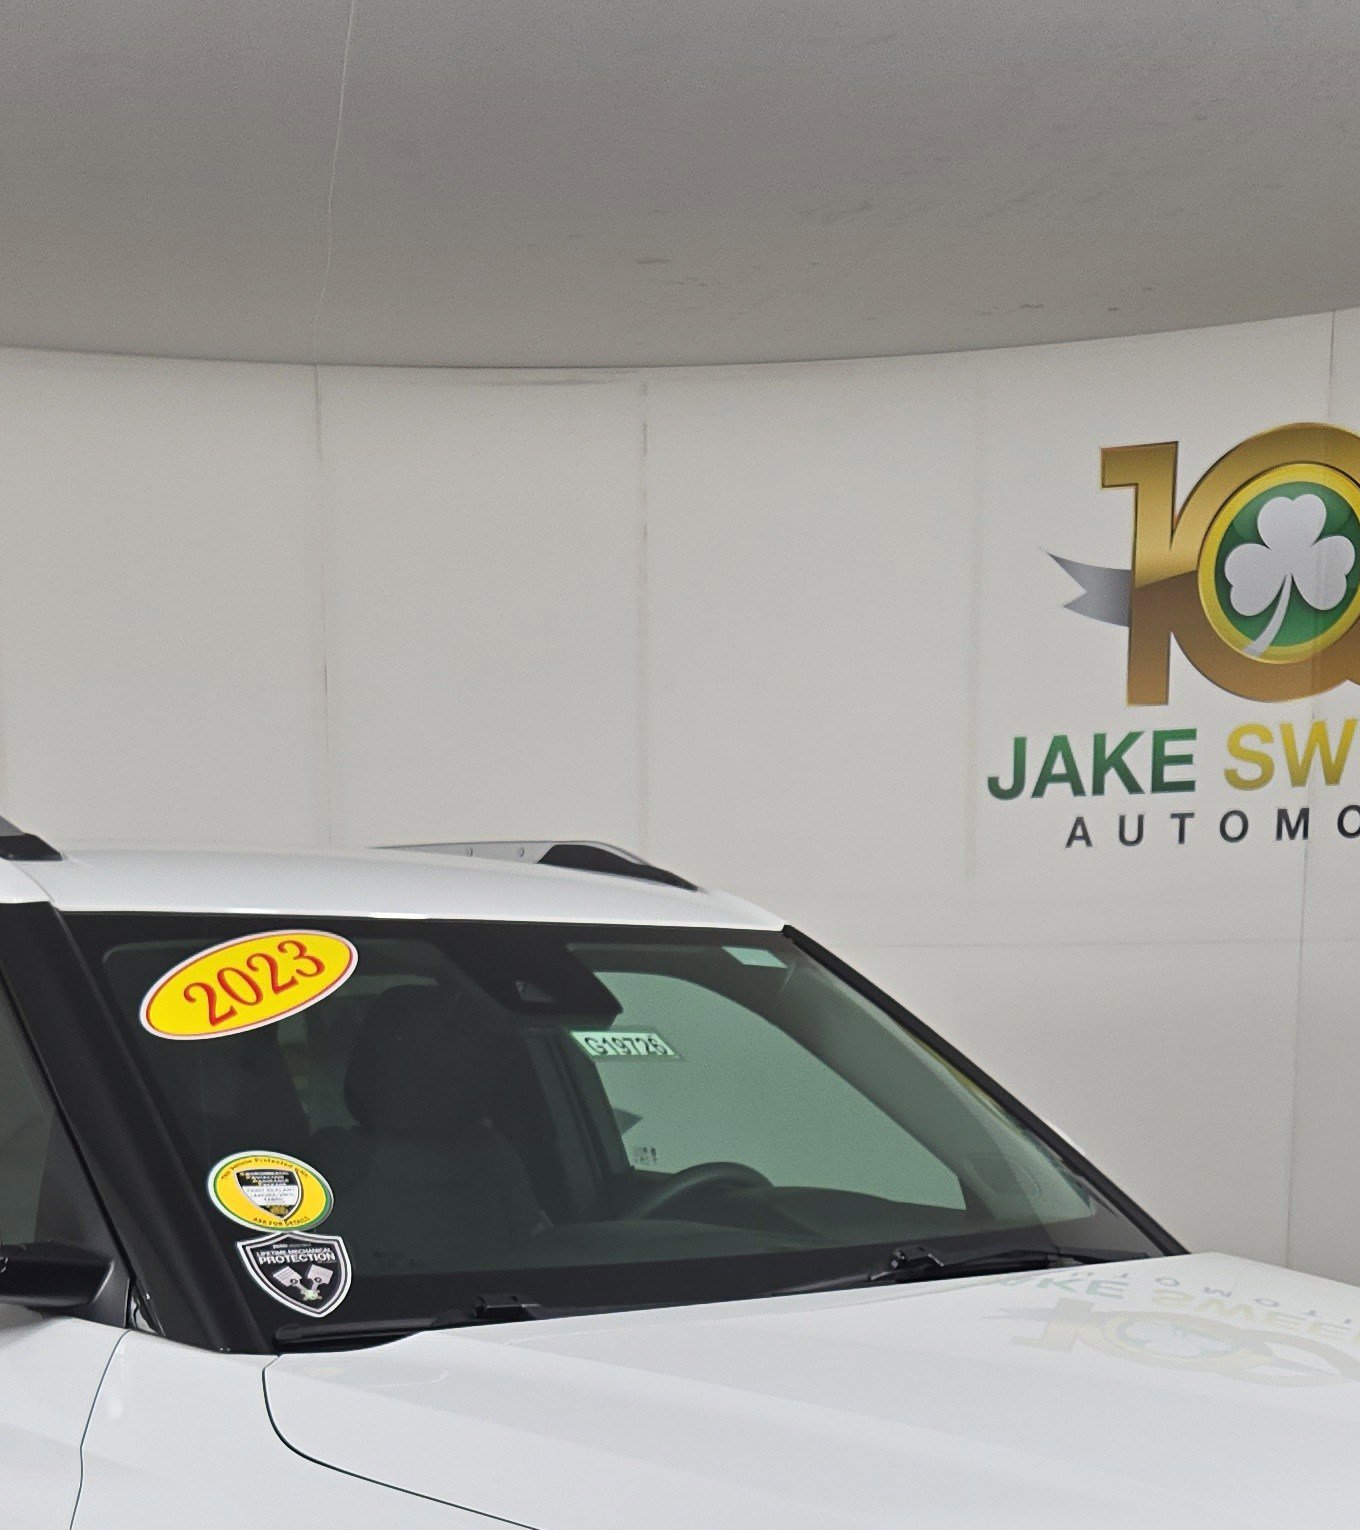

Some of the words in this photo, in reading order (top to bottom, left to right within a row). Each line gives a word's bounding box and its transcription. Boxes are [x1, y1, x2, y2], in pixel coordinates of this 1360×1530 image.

[987, 728, 1198, 800] JAKE
[183, 940, 326, 1027] 2023
[257, 1251, 336, 1265] PROTECTION
